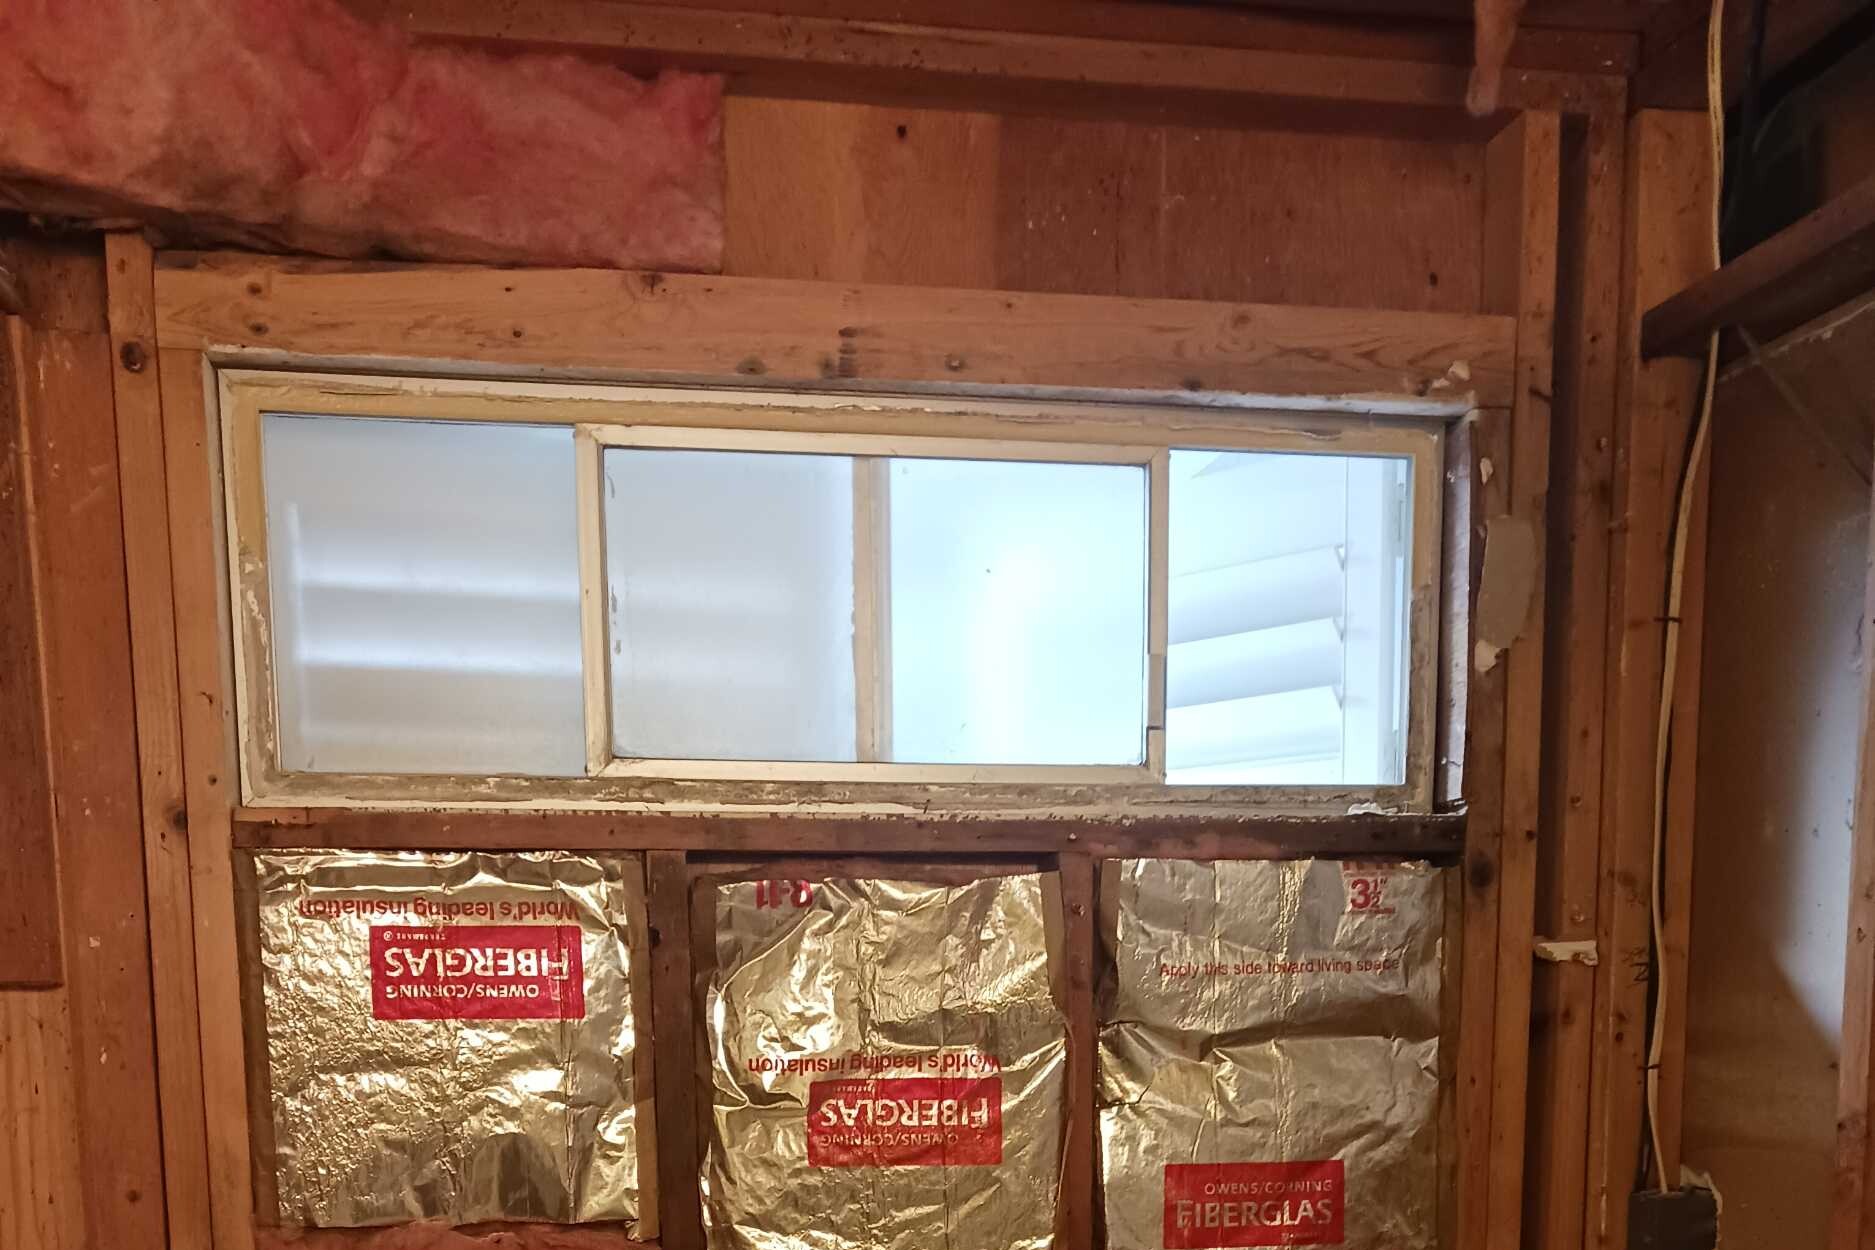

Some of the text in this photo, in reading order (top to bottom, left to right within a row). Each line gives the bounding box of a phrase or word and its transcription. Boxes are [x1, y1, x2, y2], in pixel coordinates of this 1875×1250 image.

[299, 897, 580, 921] World's leading insulation
[384, 946, 569, 980] FIBERGLAS
[1159, 957, 1400, 978] Apply this side toward living space
[385, 983, 539, 999] OWENS/CORNING
[748, 1053, 1001, 1078] World's leading insulation
[821, 1098, 989, 1129] FIBERGLAS
[1176, 1199, 1332, 1229] FIBERGLAS
